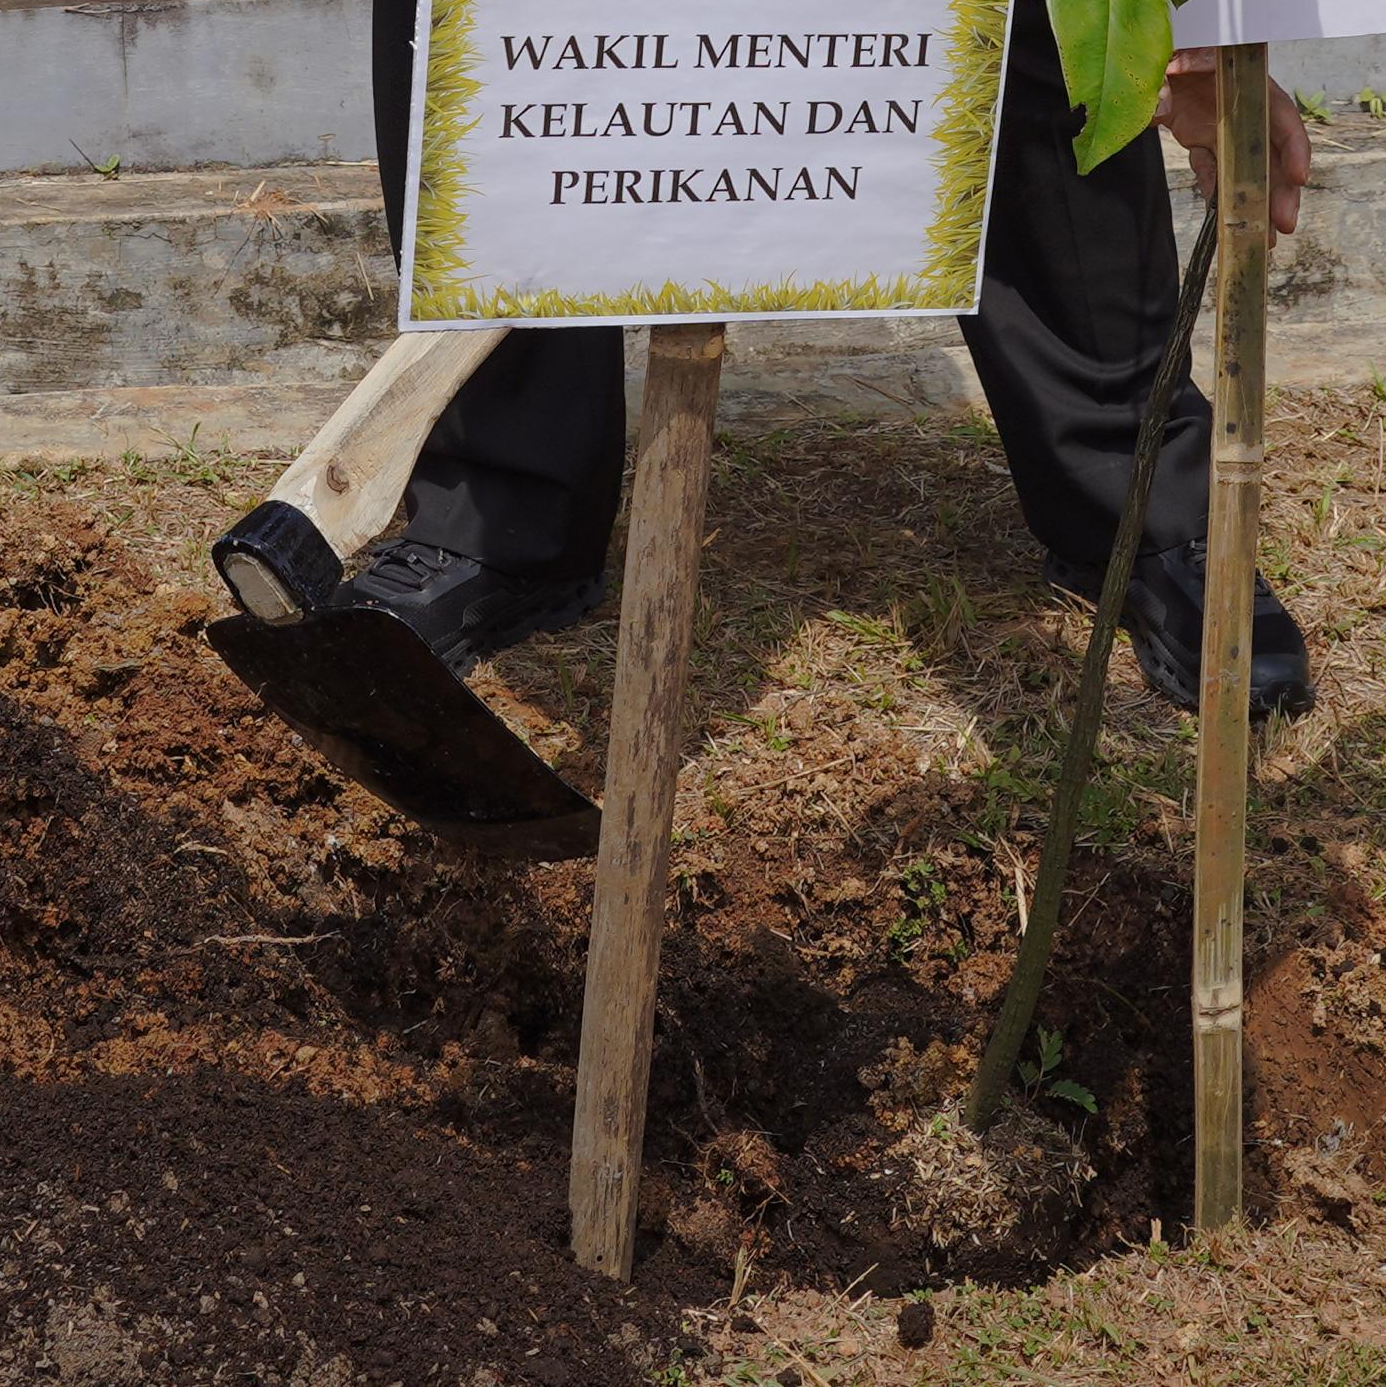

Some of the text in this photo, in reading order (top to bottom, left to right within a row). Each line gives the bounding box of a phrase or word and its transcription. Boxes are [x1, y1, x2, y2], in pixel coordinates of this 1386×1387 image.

[500, 33, 933, 71] WAKIL MENTERI
[498, 99, 923, 139] KELAUTAN DAN
[549, 166, 863, 206] PERIKANAN
